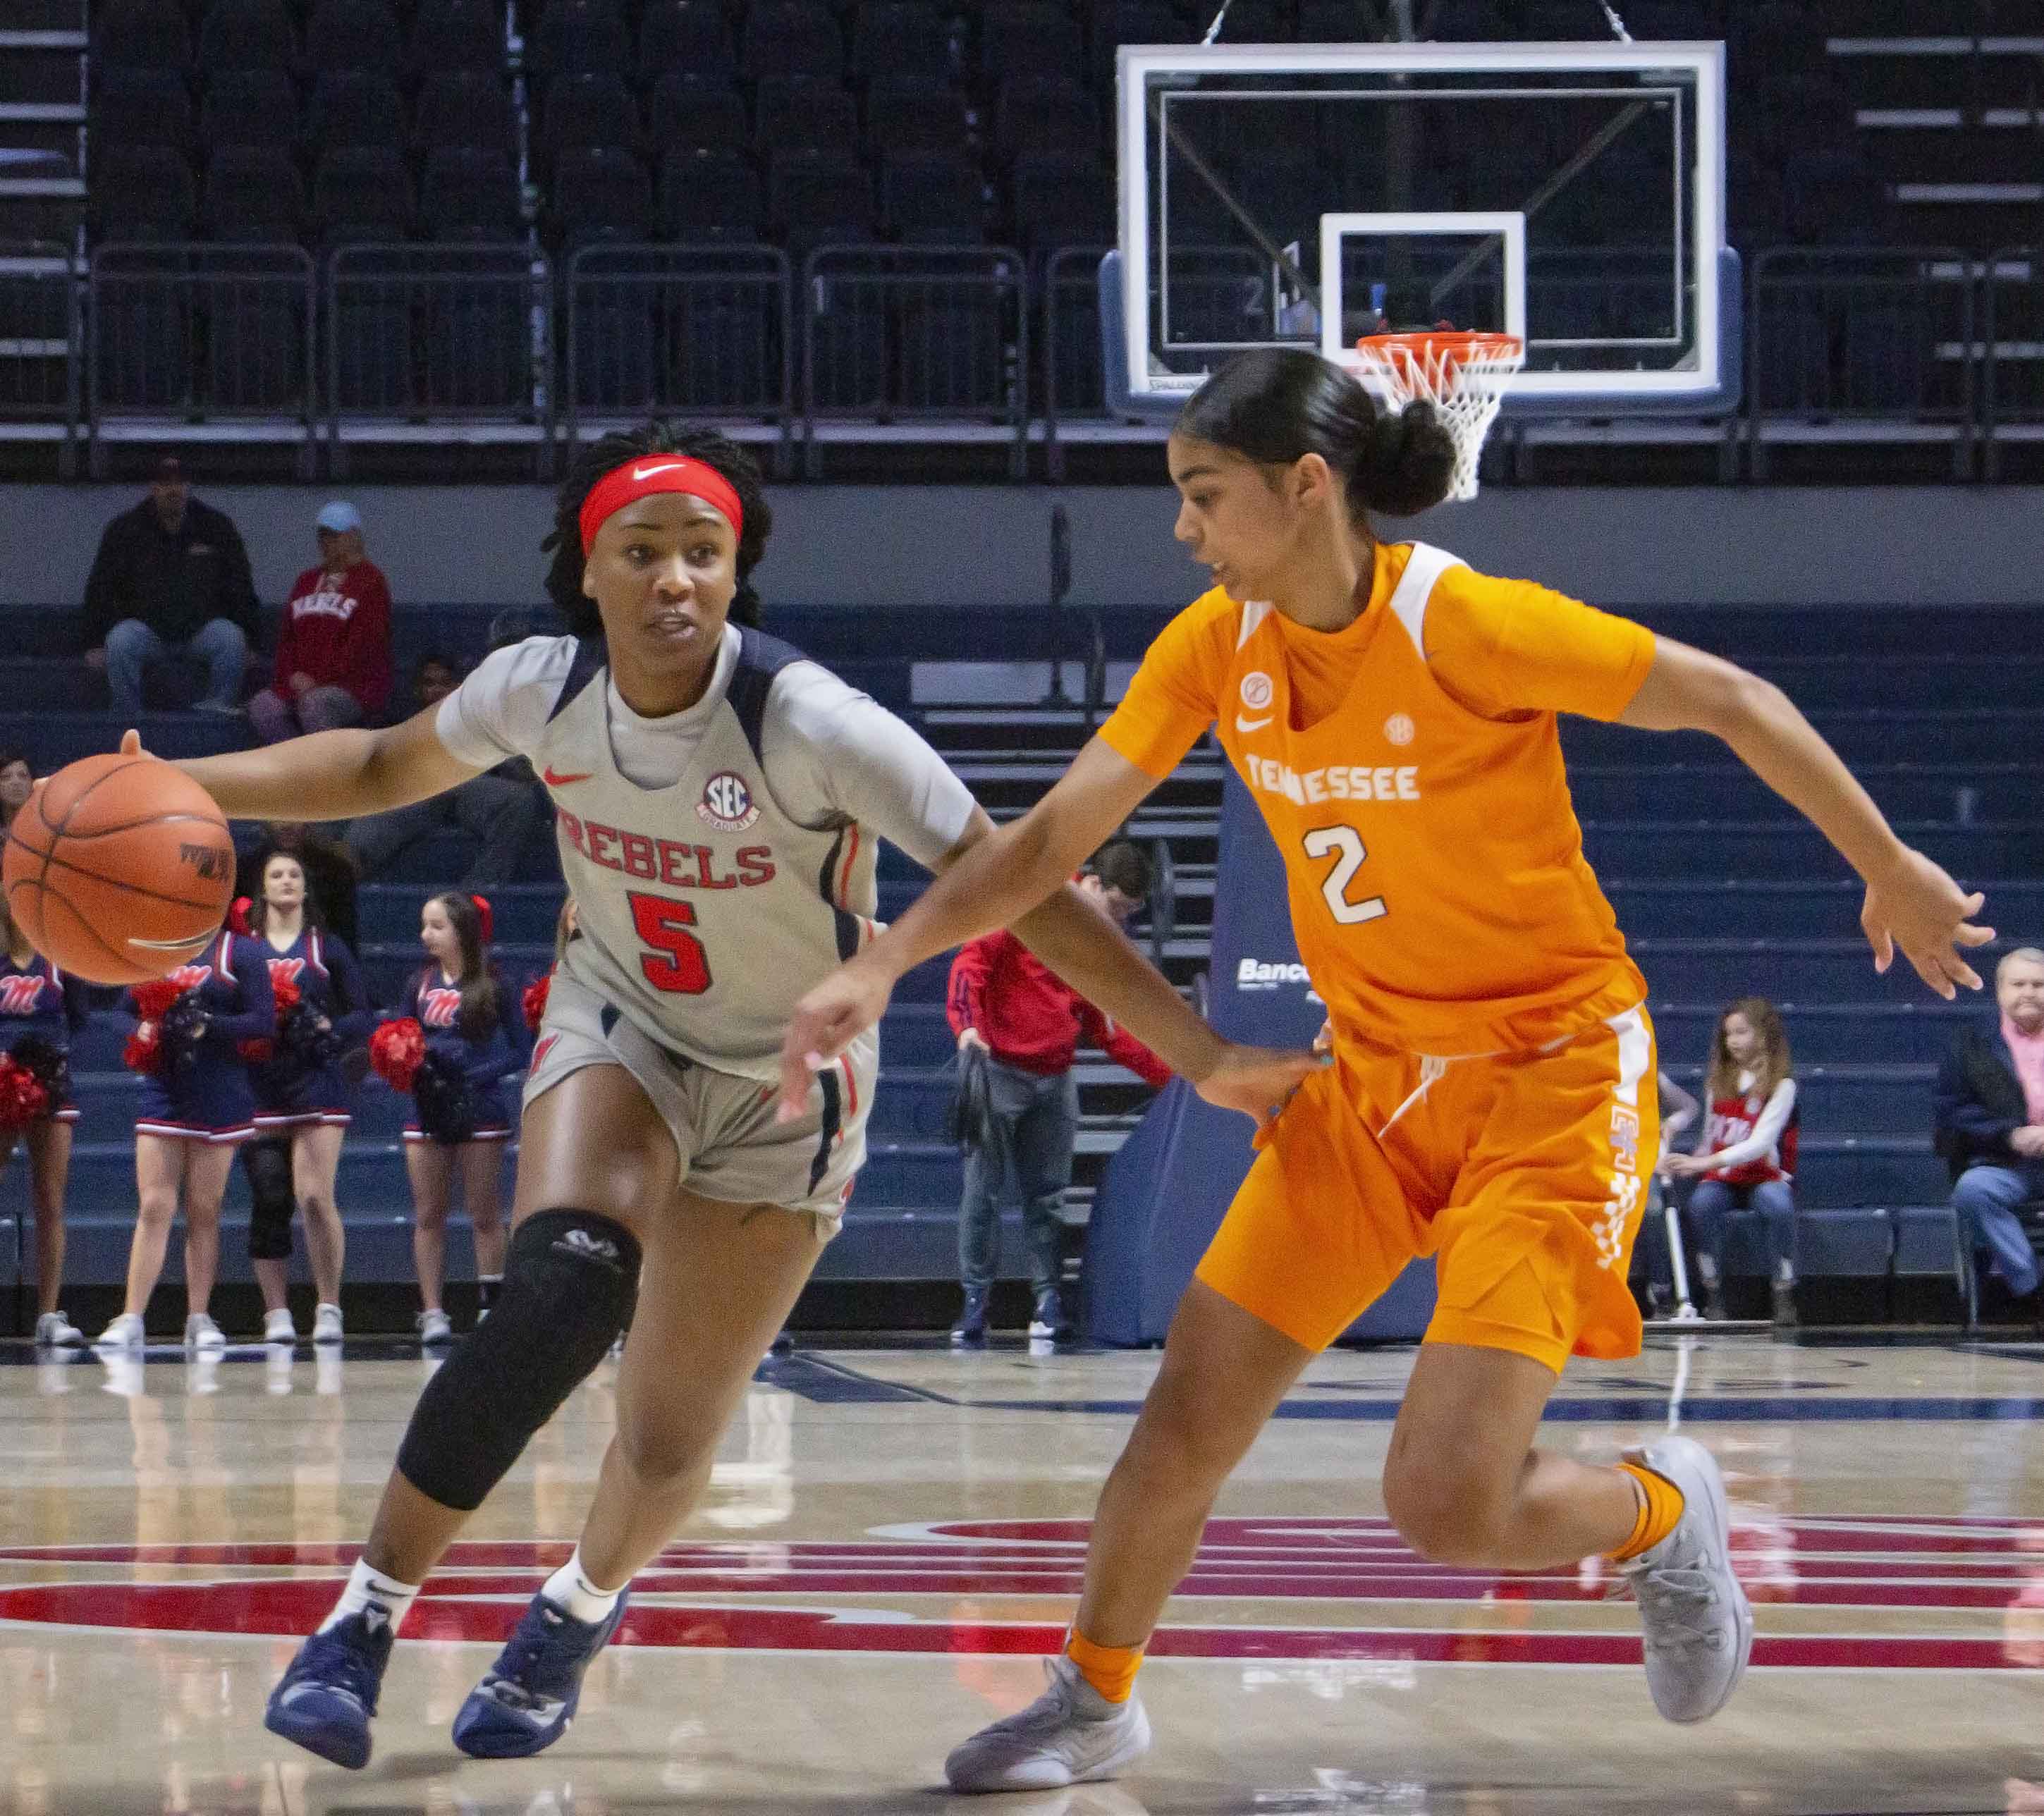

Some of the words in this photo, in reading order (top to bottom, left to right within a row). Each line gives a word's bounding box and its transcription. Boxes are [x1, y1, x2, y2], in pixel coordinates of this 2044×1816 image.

[707, 775, 747, 818] SEC
[557, 805, 776, 890] REBELS
[1302, 823, 1388, 925] 2
[626, 890, 714, 995] 5
